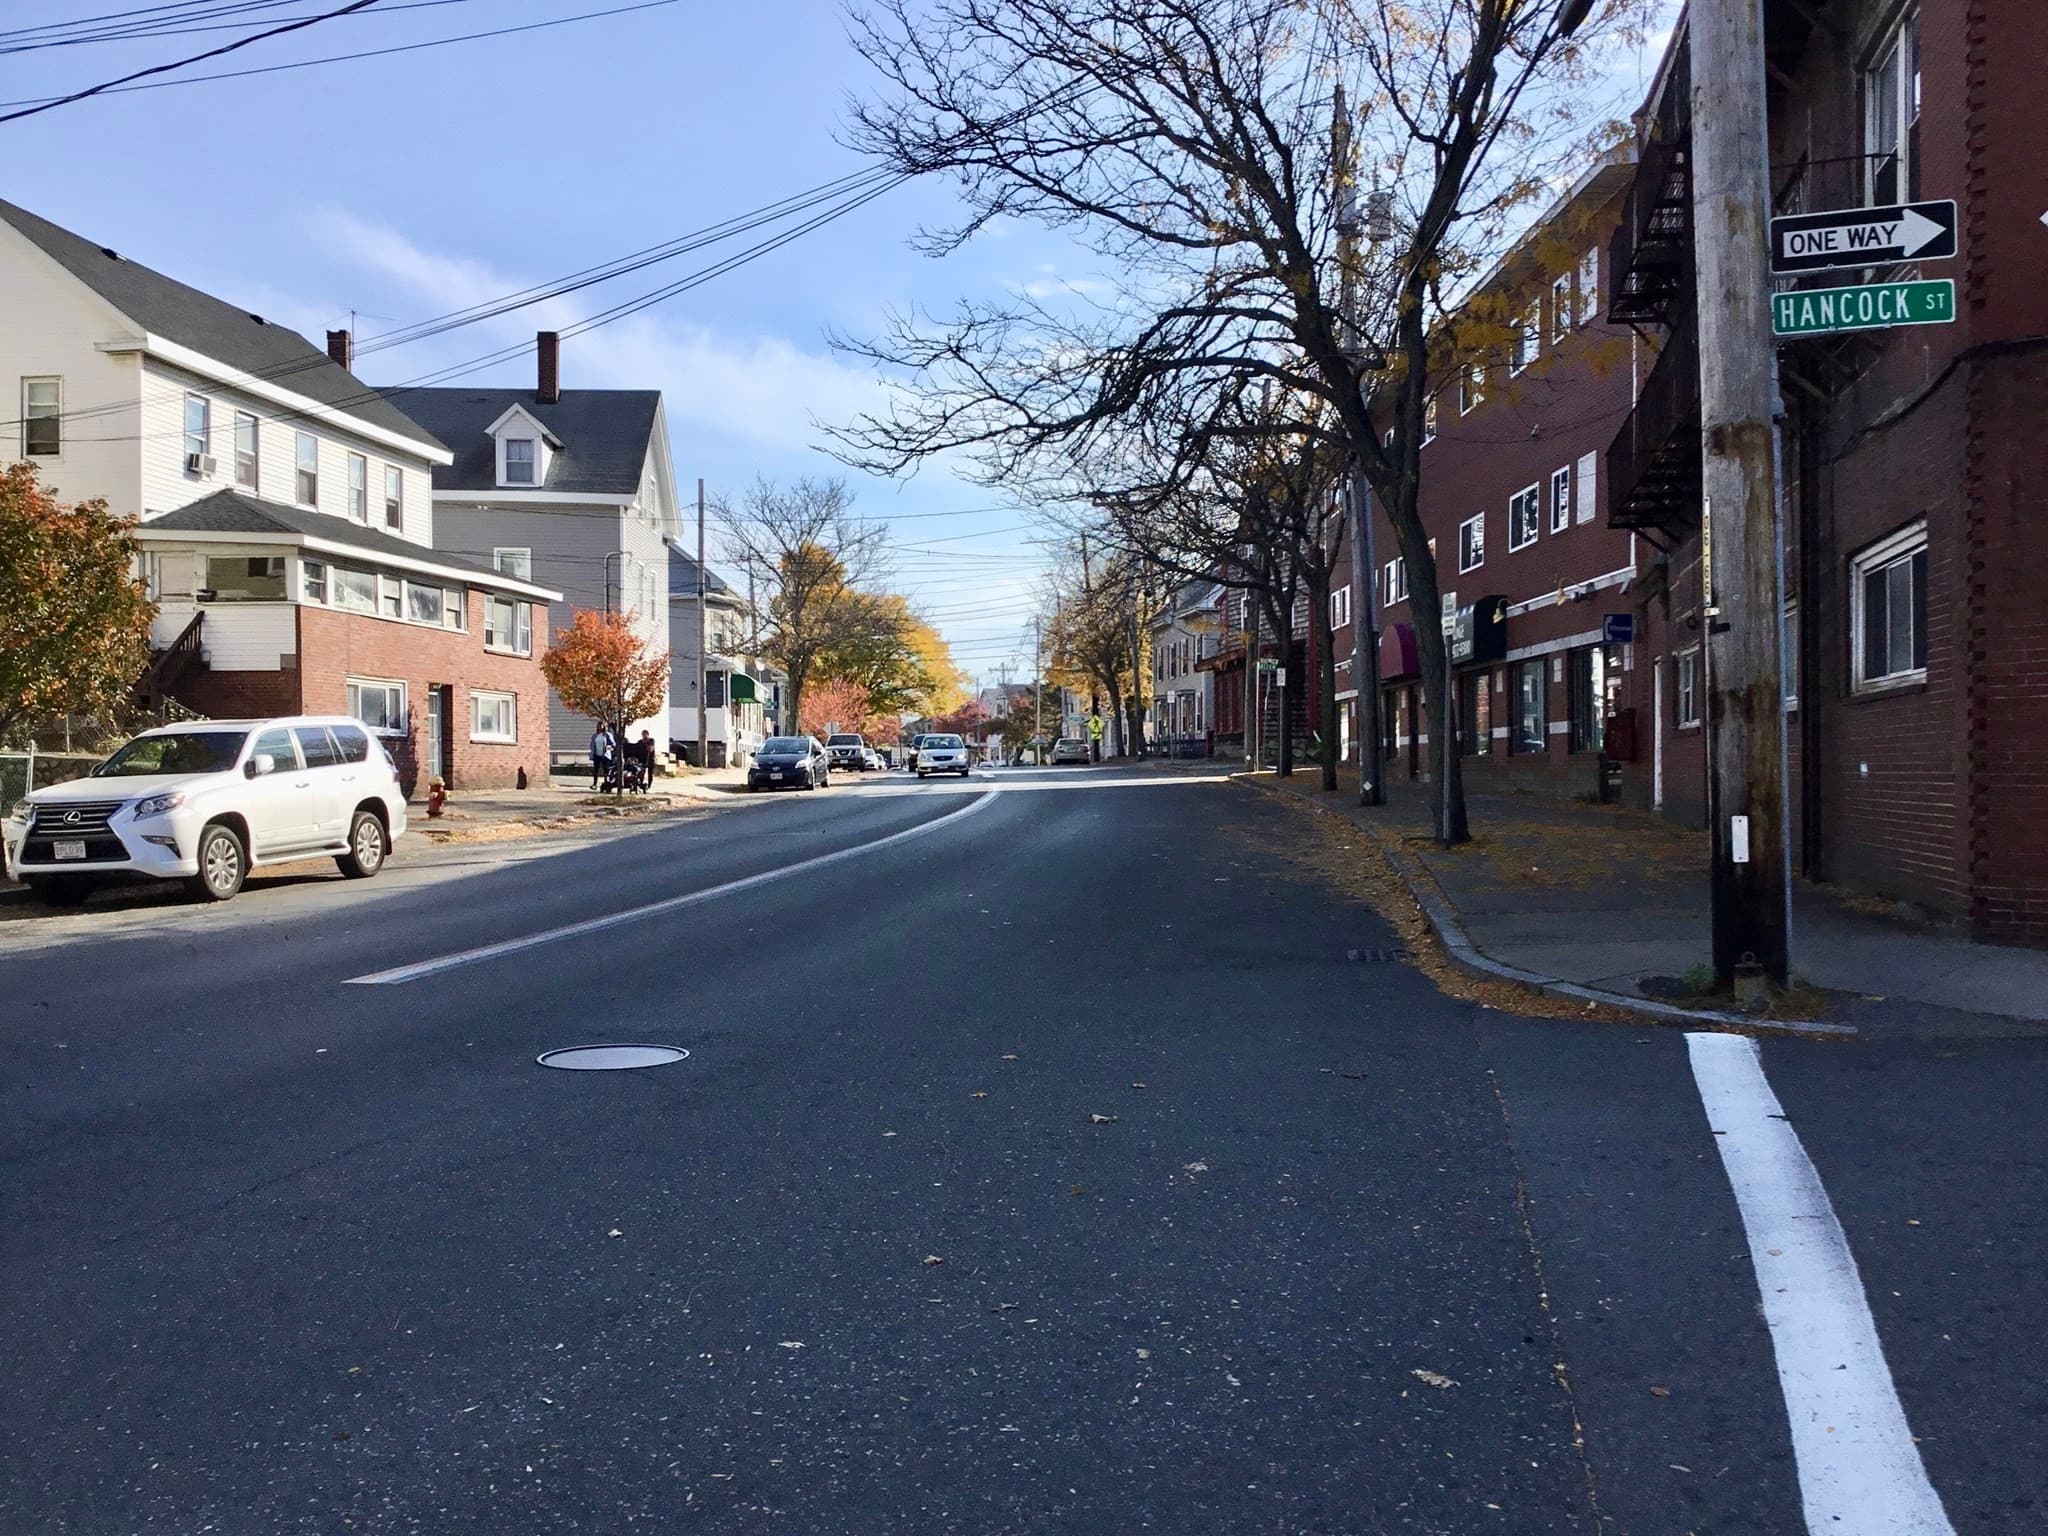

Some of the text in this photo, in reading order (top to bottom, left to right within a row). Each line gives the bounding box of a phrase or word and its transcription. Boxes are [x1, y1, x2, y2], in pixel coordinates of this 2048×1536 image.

[1790, 223, 1898, 254] ONE WAY
[1780, 288, 1945, 328] HANCOCK ST
